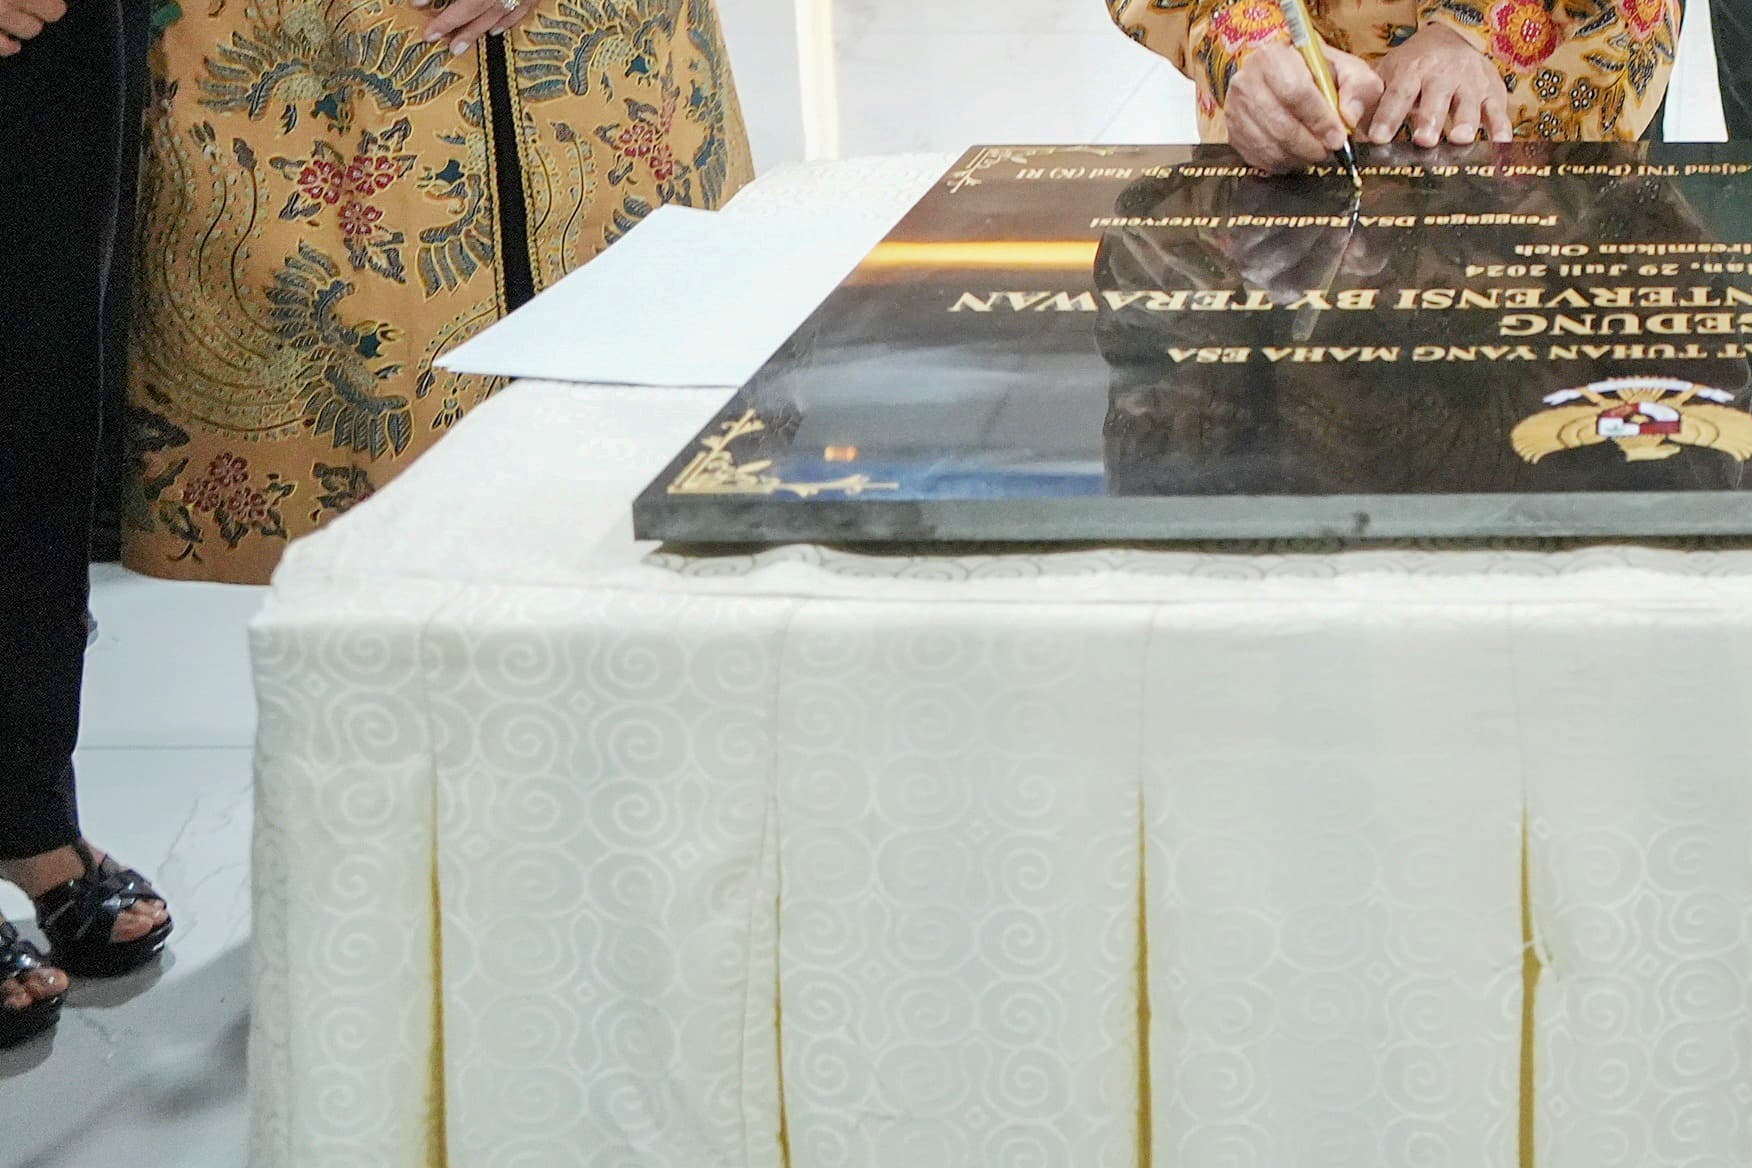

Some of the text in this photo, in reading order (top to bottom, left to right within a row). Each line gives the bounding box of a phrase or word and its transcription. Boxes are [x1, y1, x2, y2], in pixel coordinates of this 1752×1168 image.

[1015, 168, 1045, 180] RI
[1050, 167, 1085, 180] (K)
[1432, 165, 1459, 177] dr.
[1465, 165, 1496, 177] Dr.
[1501, 165, 1552, 177] Prof.
[1558, 163, 1631, 177] (Purn.)
[1637, 164, 1679, 177] TNI
[1090, 213, 1558, 229] Penggagas DSA Radiologi Intervensi
[1514, 243, 1589, 257] Oleh
[1464, 264, 1548, 278] 2024
[1558, 264, 1628, 277] Juli
[1639, 263, 1678, 276] 29
[947, 289, 1273, 313] TERAWAN
[1287, 288, 1379, 311] BY
[1167, 347, 1252, 363] ESA
[1262, 346, 1401, 363] MAHA
[1412, 345, 1538, 362] YANG
[1548, 343, 1708, 360] TUHAN
